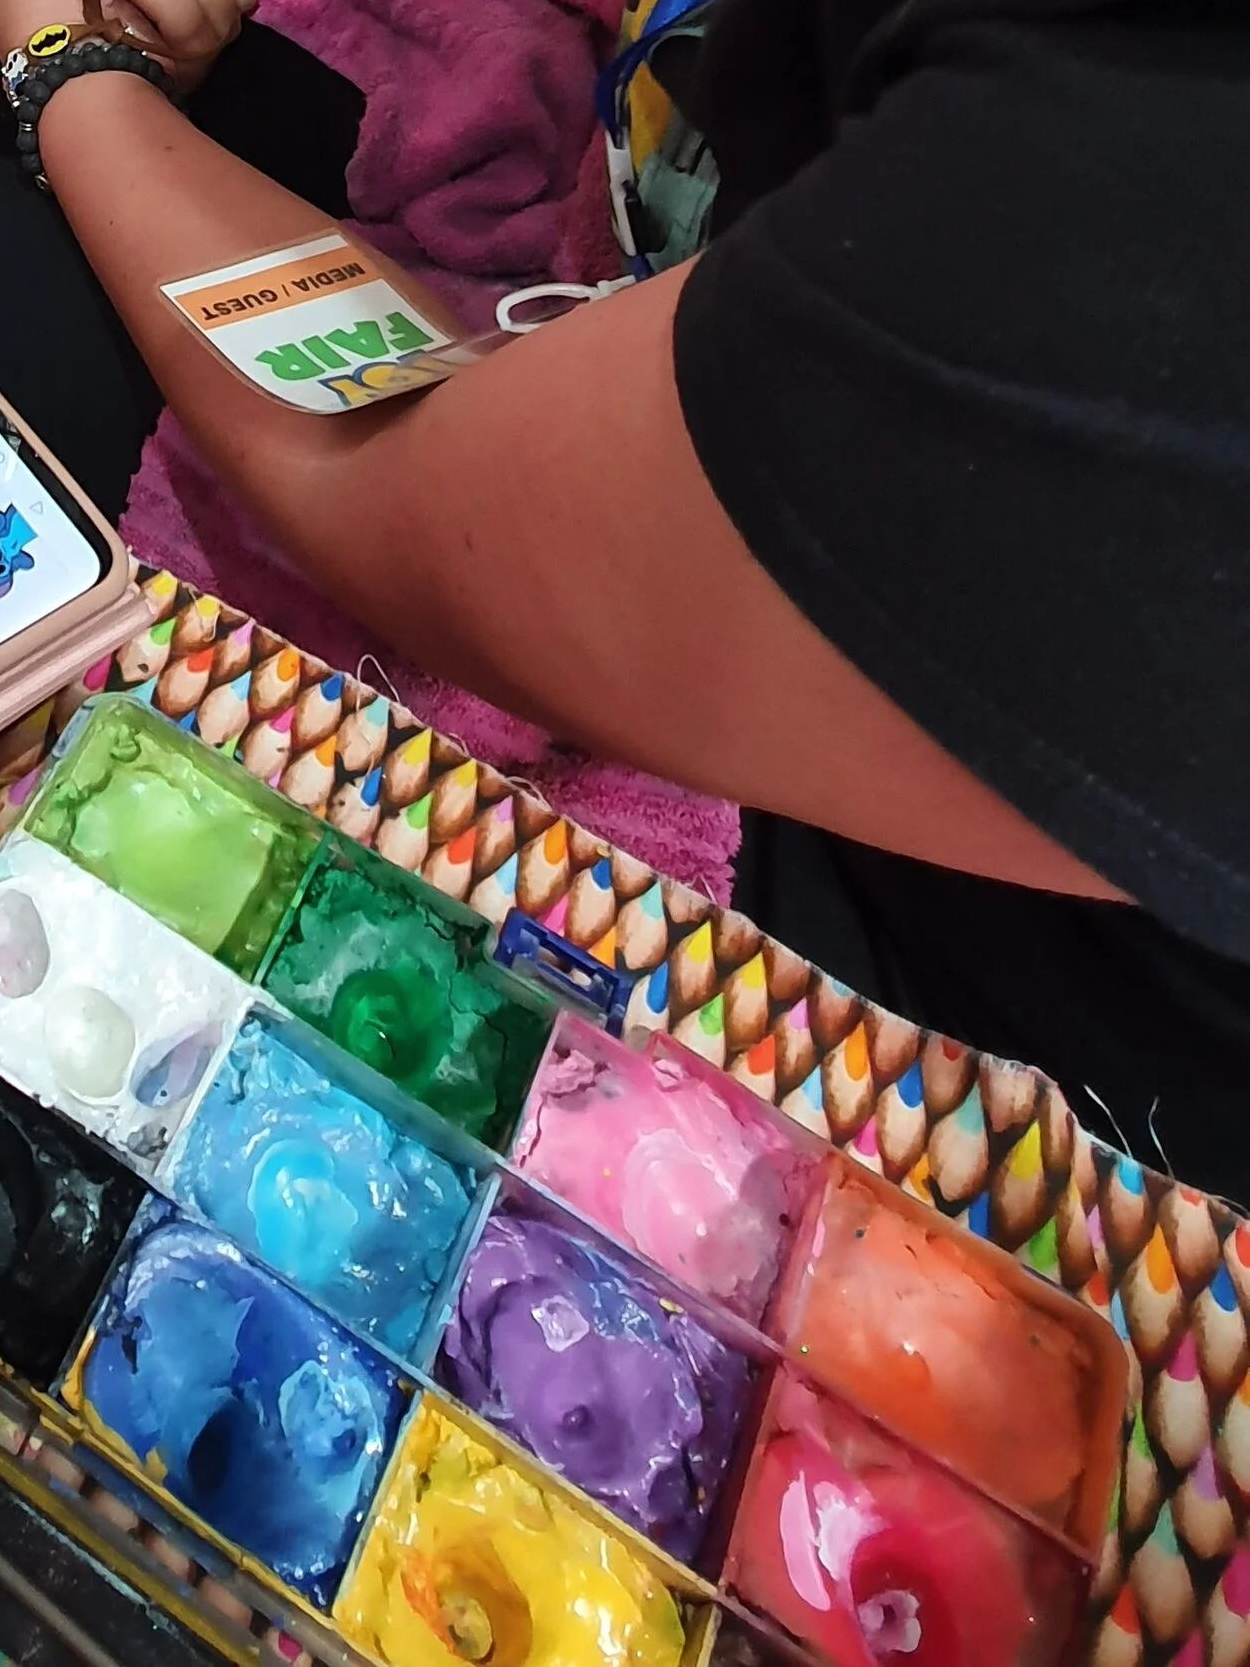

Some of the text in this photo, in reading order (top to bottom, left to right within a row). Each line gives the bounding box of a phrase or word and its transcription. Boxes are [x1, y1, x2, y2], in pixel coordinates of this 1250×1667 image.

[291, 262, 367, 293] MEDIA
[200, 288, 279, 321] GUEST
[255, 311, 435, 381] FAIR
